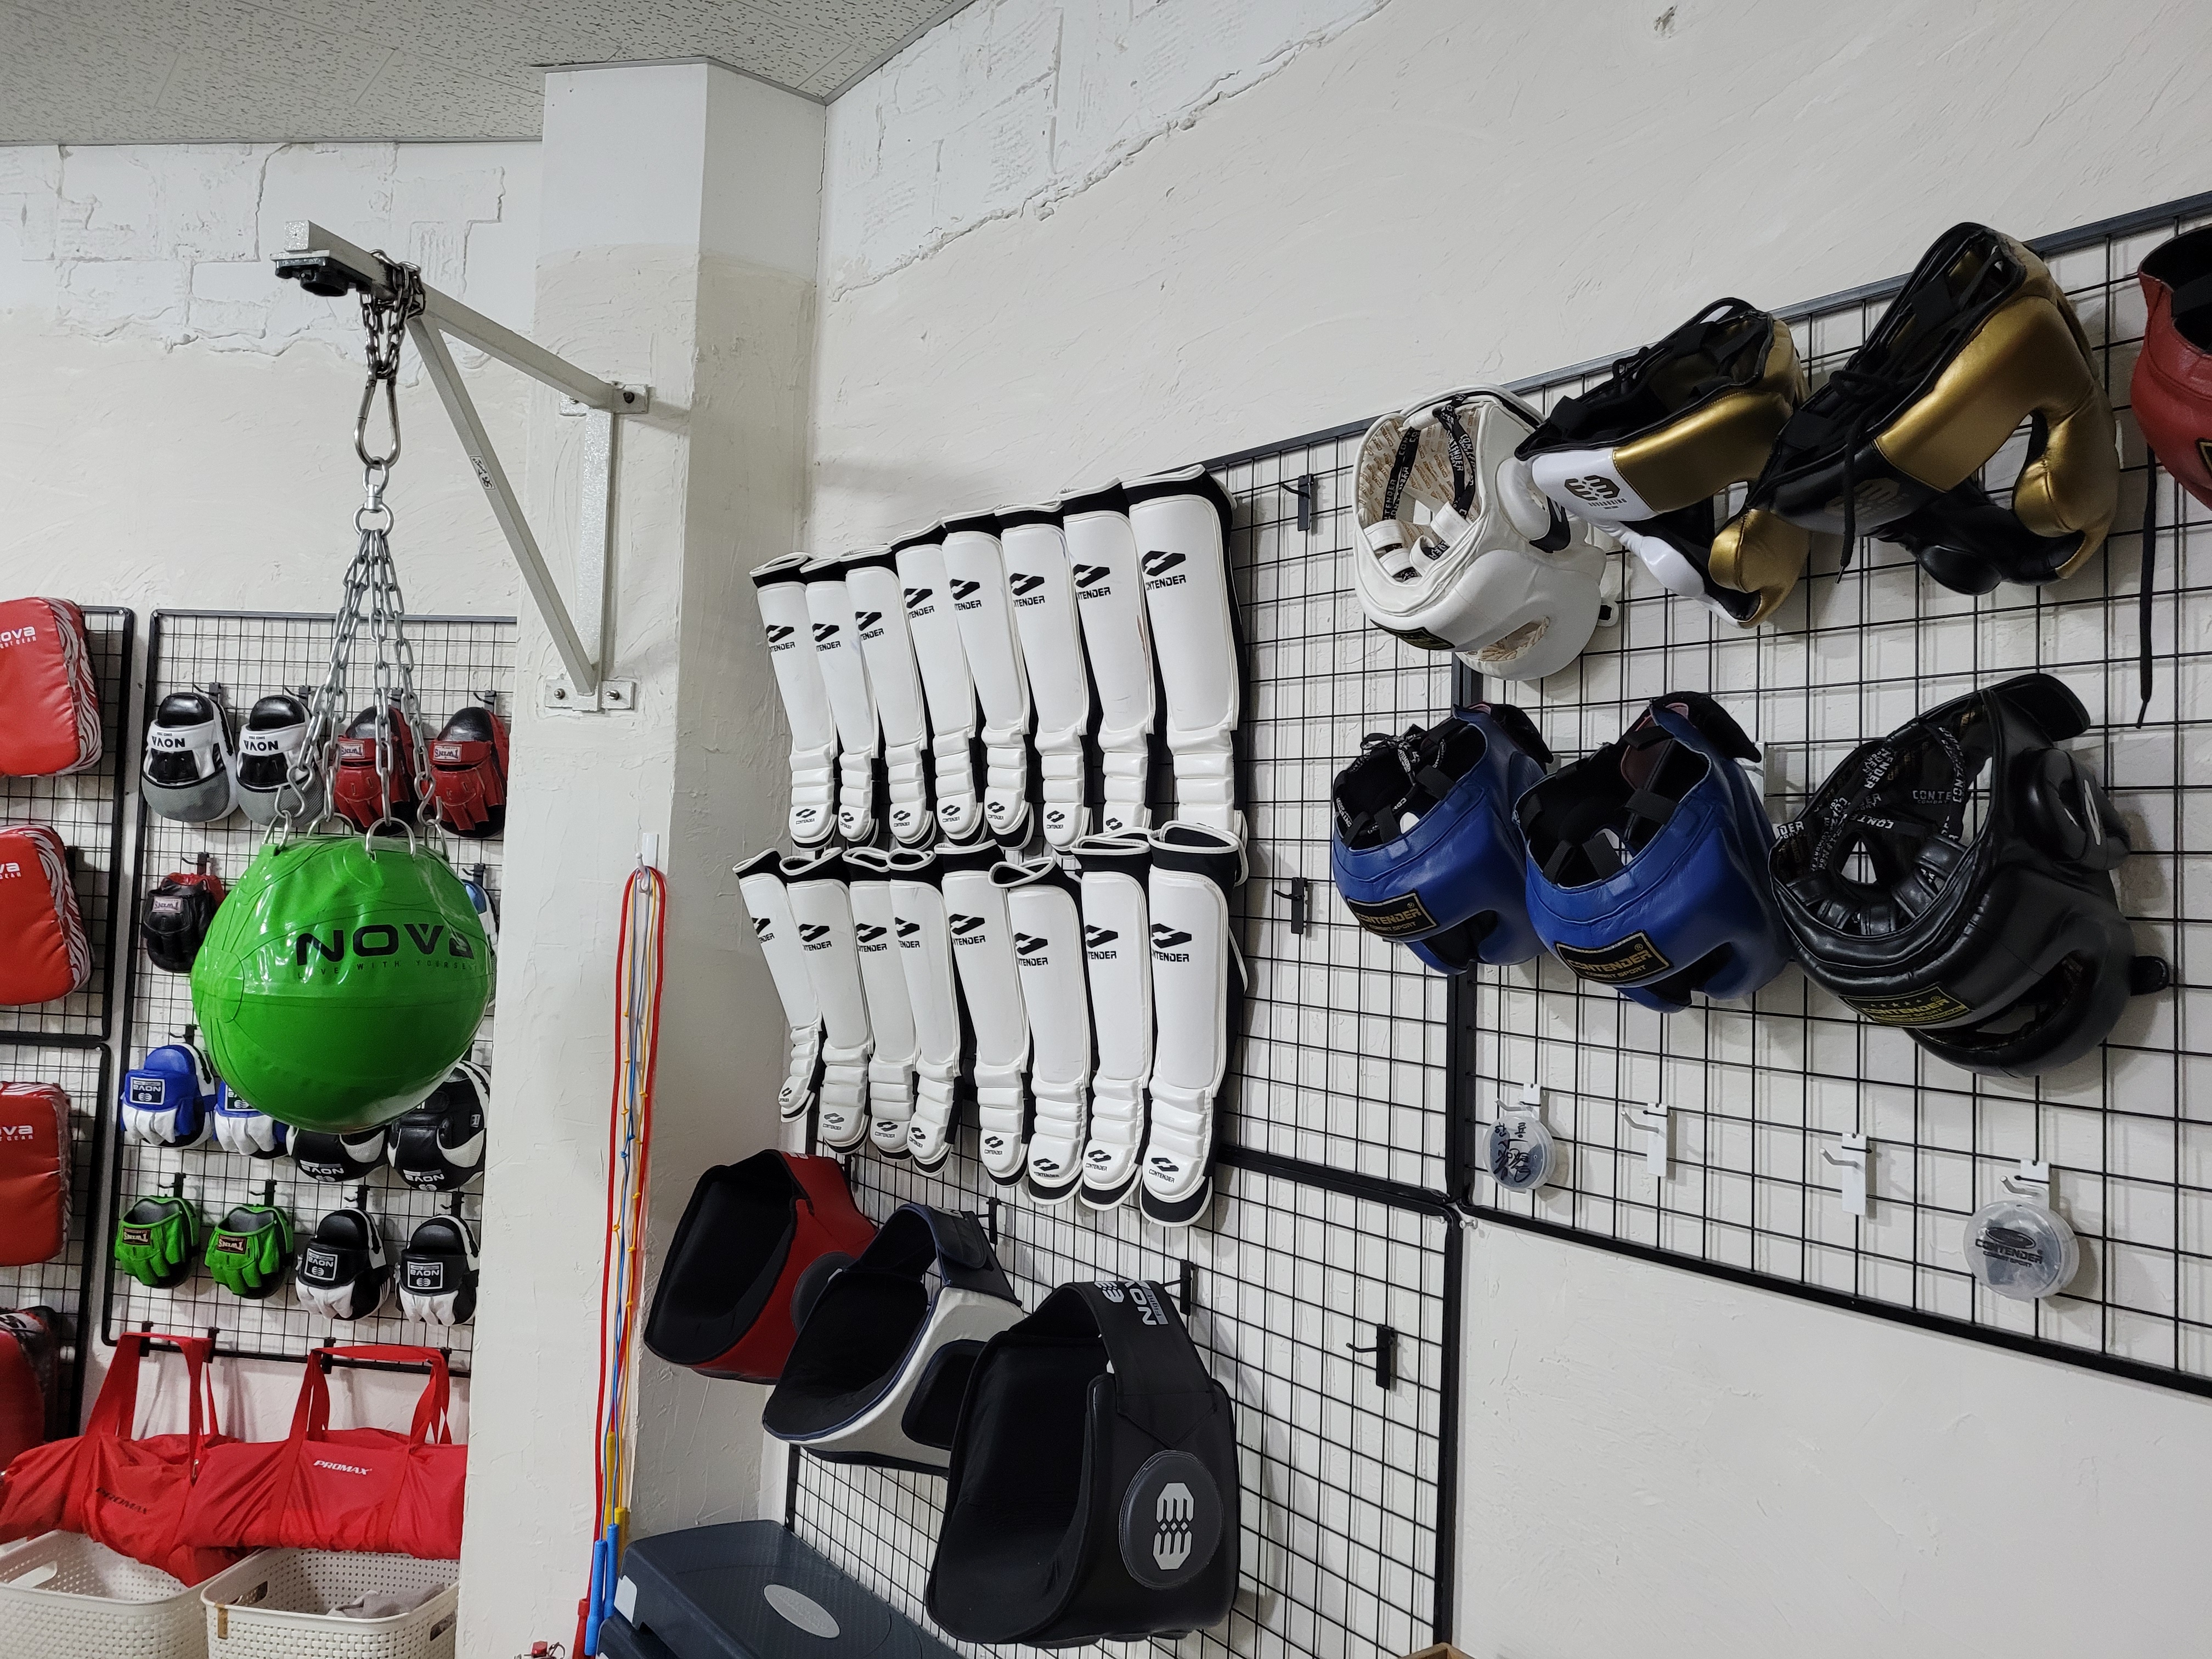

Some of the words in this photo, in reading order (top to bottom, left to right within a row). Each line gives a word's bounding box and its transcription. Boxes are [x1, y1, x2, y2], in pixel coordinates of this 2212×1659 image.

[0, 627, 36, 642] OVA
[151, 736, 185, 748] NOVA
[244, 740, 279, 751] NOVA
[435, 748, 459, 759] TWINS
[1912, 791, 1951, 800] CONTE
[155, 901, 179, 911] TWINS
[357, 961, 399, 970] WITH
[1618, 964, 1646, 977] SPORT
[1149, 1169, 1175, 1183] CONTENDER
[124, 1232, 148, 1242] TWINS
[218, 1239, 243, 1251] TWINS
[308, 1257, 334, 1267] NOVA
[313, 1460, 368, 1475] PROMAX
